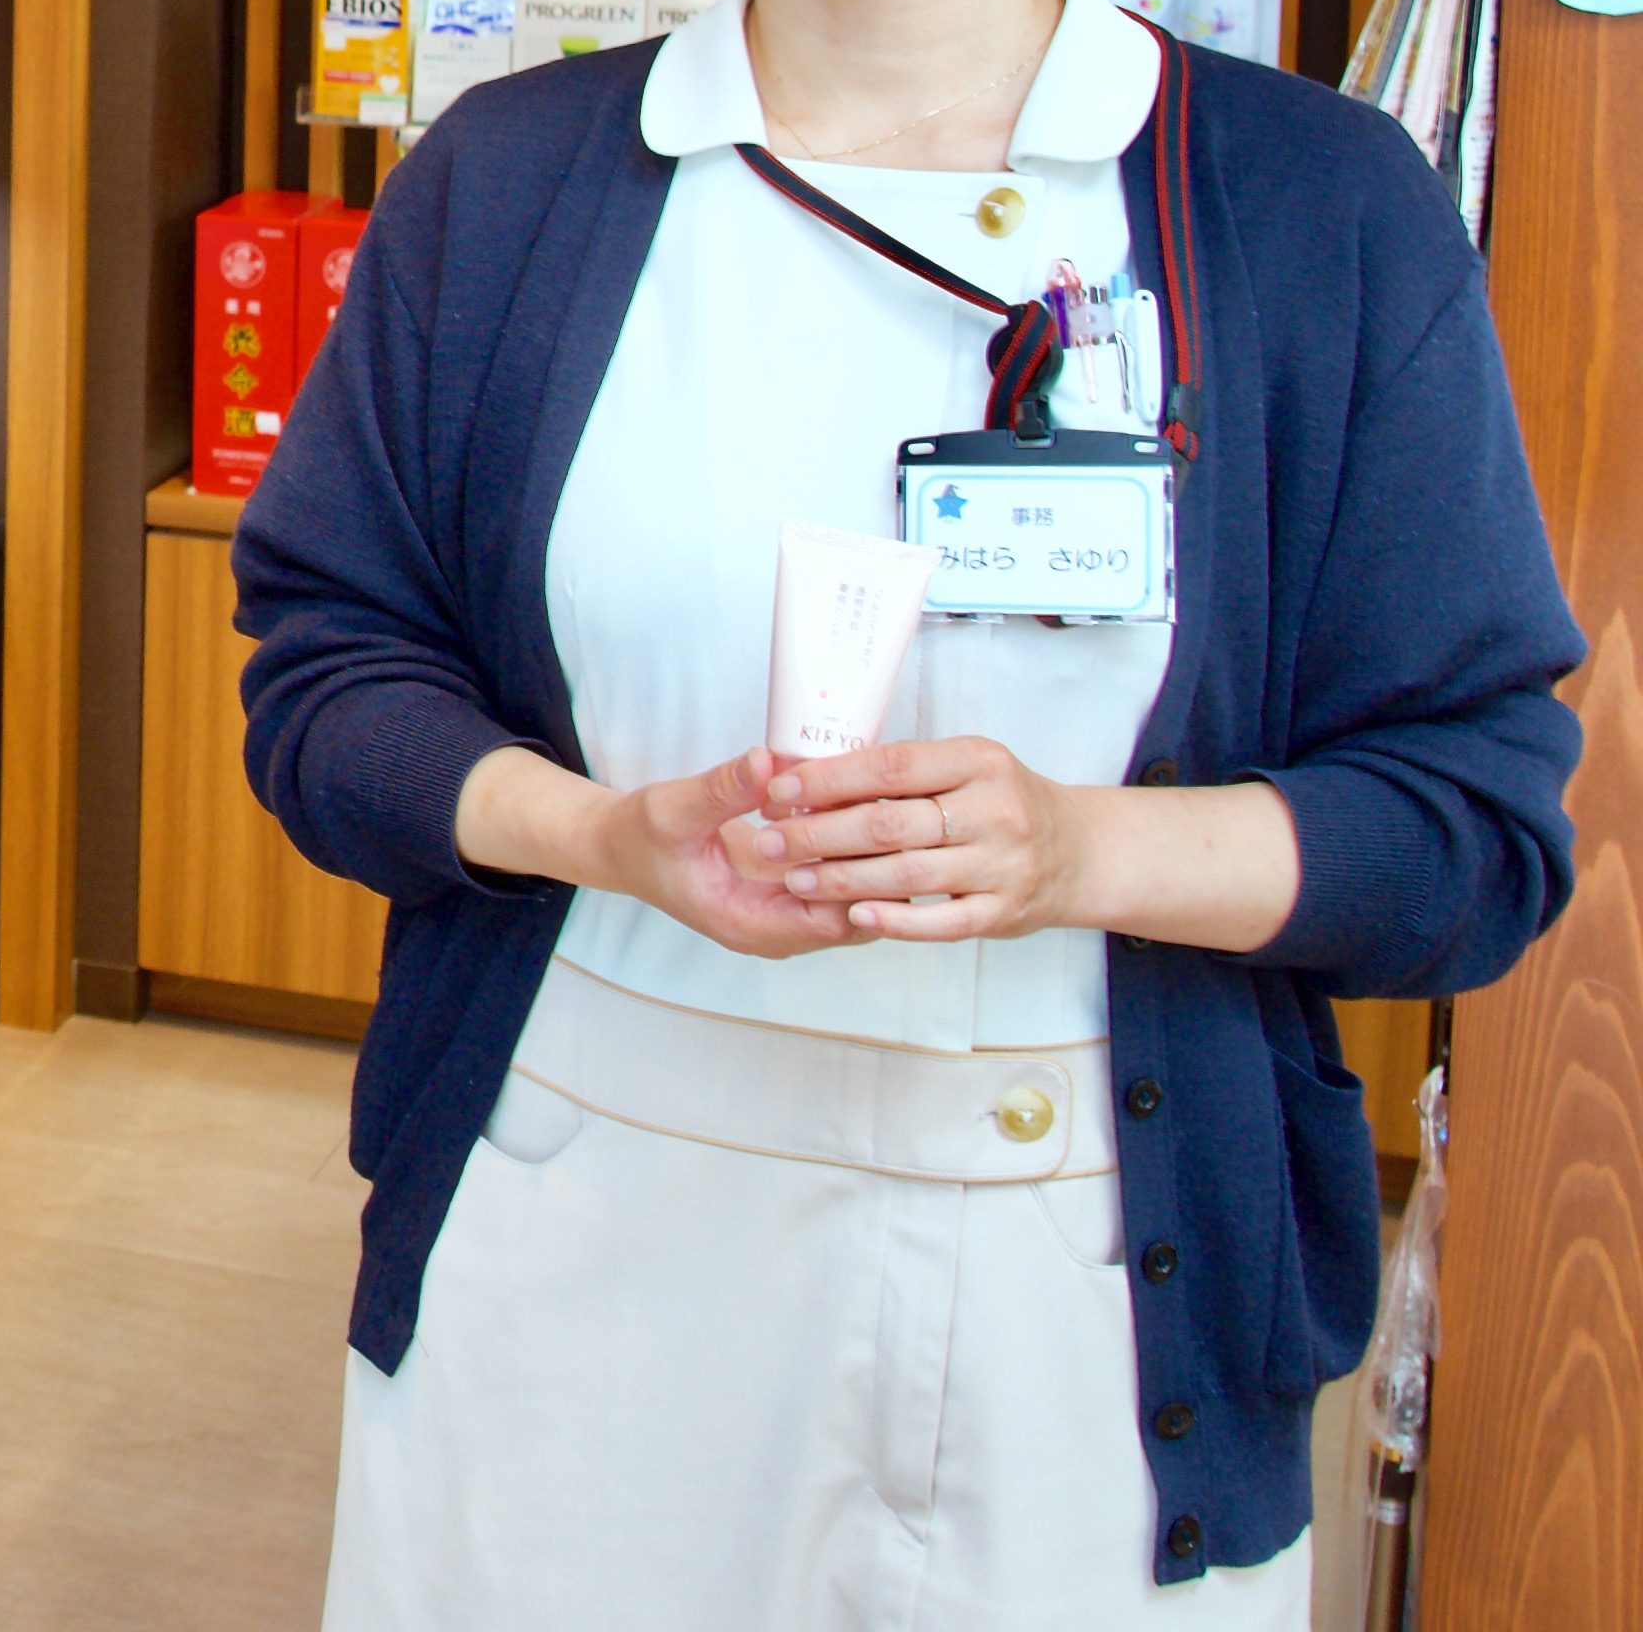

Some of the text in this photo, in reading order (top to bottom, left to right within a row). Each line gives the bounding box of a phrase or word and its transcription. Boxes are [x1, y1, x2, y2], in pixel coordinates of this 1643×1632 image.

[525, 1, 637, 24] PROGREEN
[1011, 506, 1054, 527] 事務
[938, 545, 1130, 573] みはら さゆり
